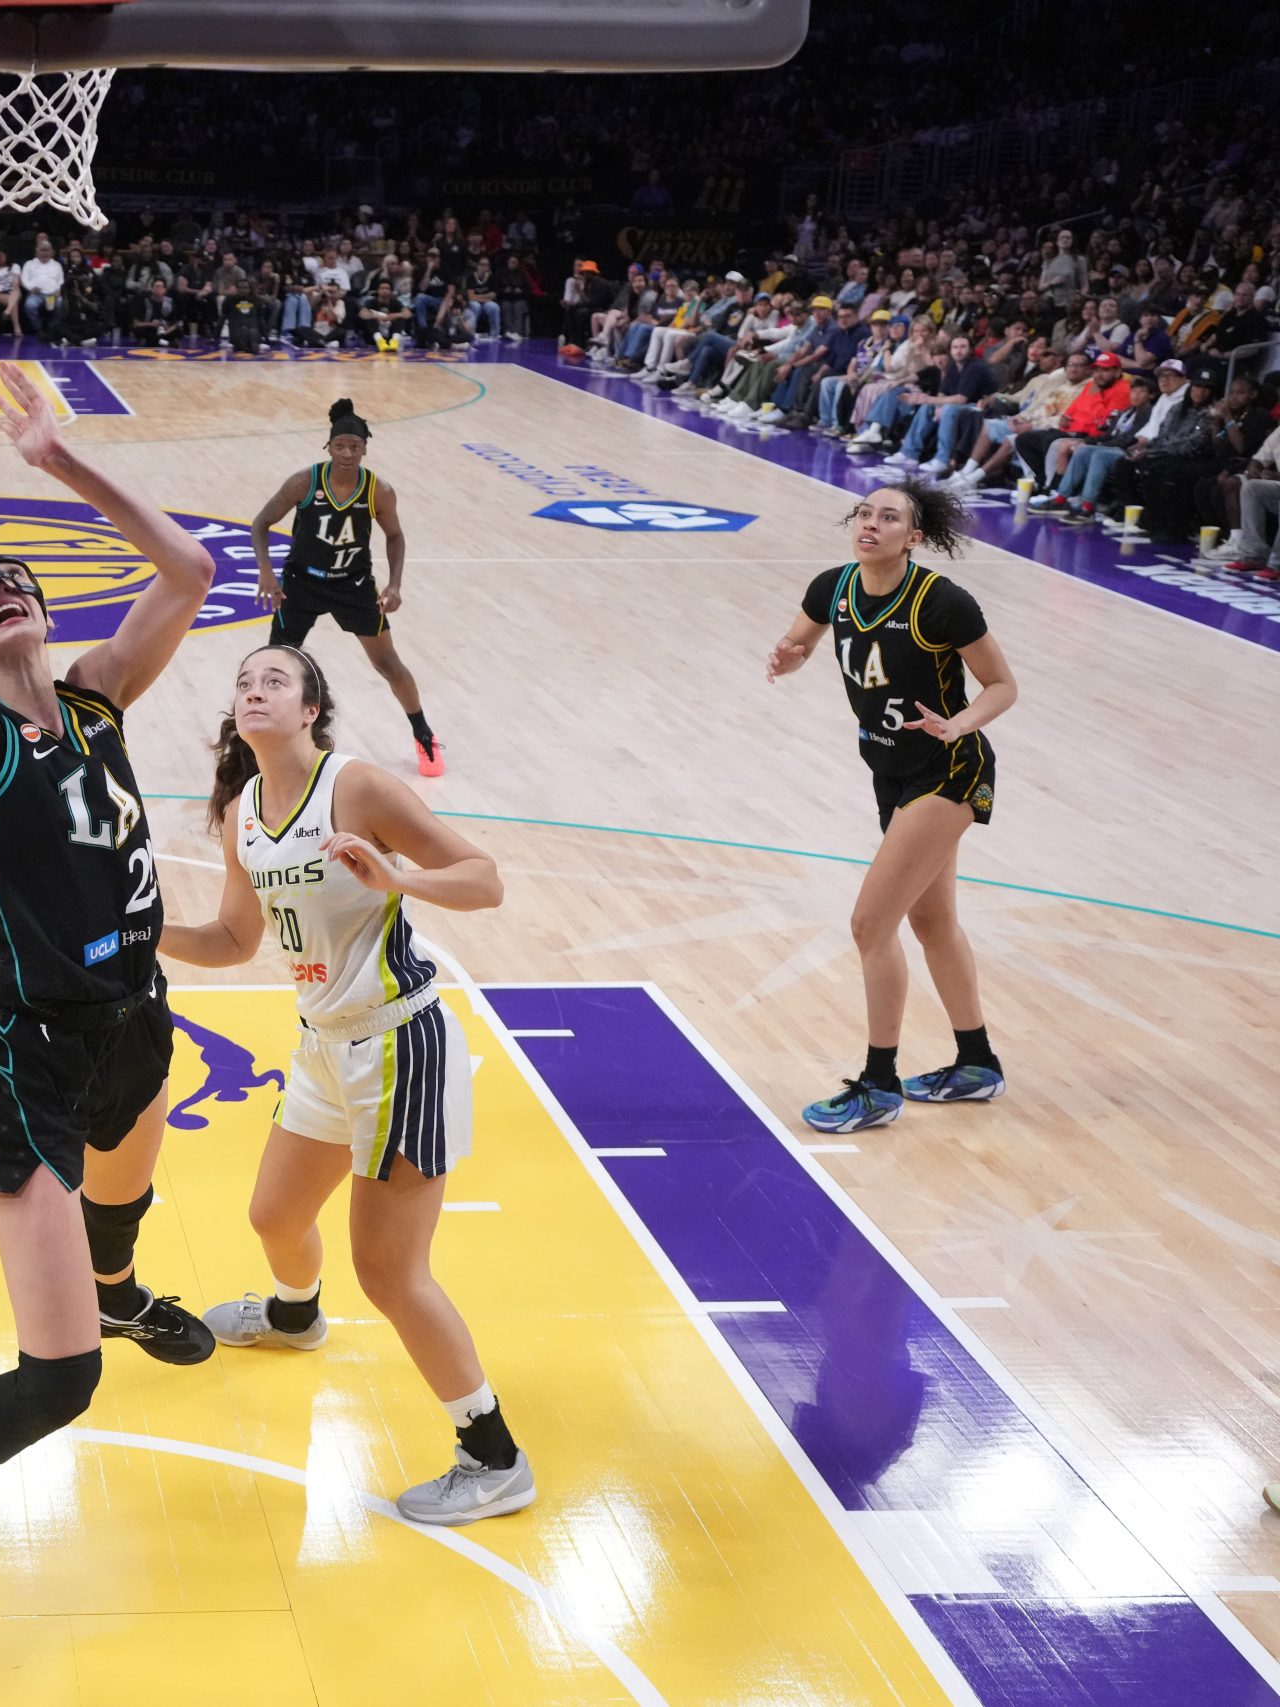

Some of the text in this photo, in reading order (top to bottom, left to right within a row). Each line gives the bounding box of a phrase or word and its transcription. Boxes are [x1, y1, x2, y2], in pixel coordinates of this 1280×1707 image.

[316, 515, 356, 546] LA
[330, 547, 362, 569] 17
[885, 619, 909, 630] Albert
[839, 637, 891, 690] LA
[881, 698, 904, 731] 5
[58, 762, 141, 850] LA
[292, 826, 321, 840] Albert
[270, 906, 304, 953] 20
[90, 937, 117, 961] UCLA
